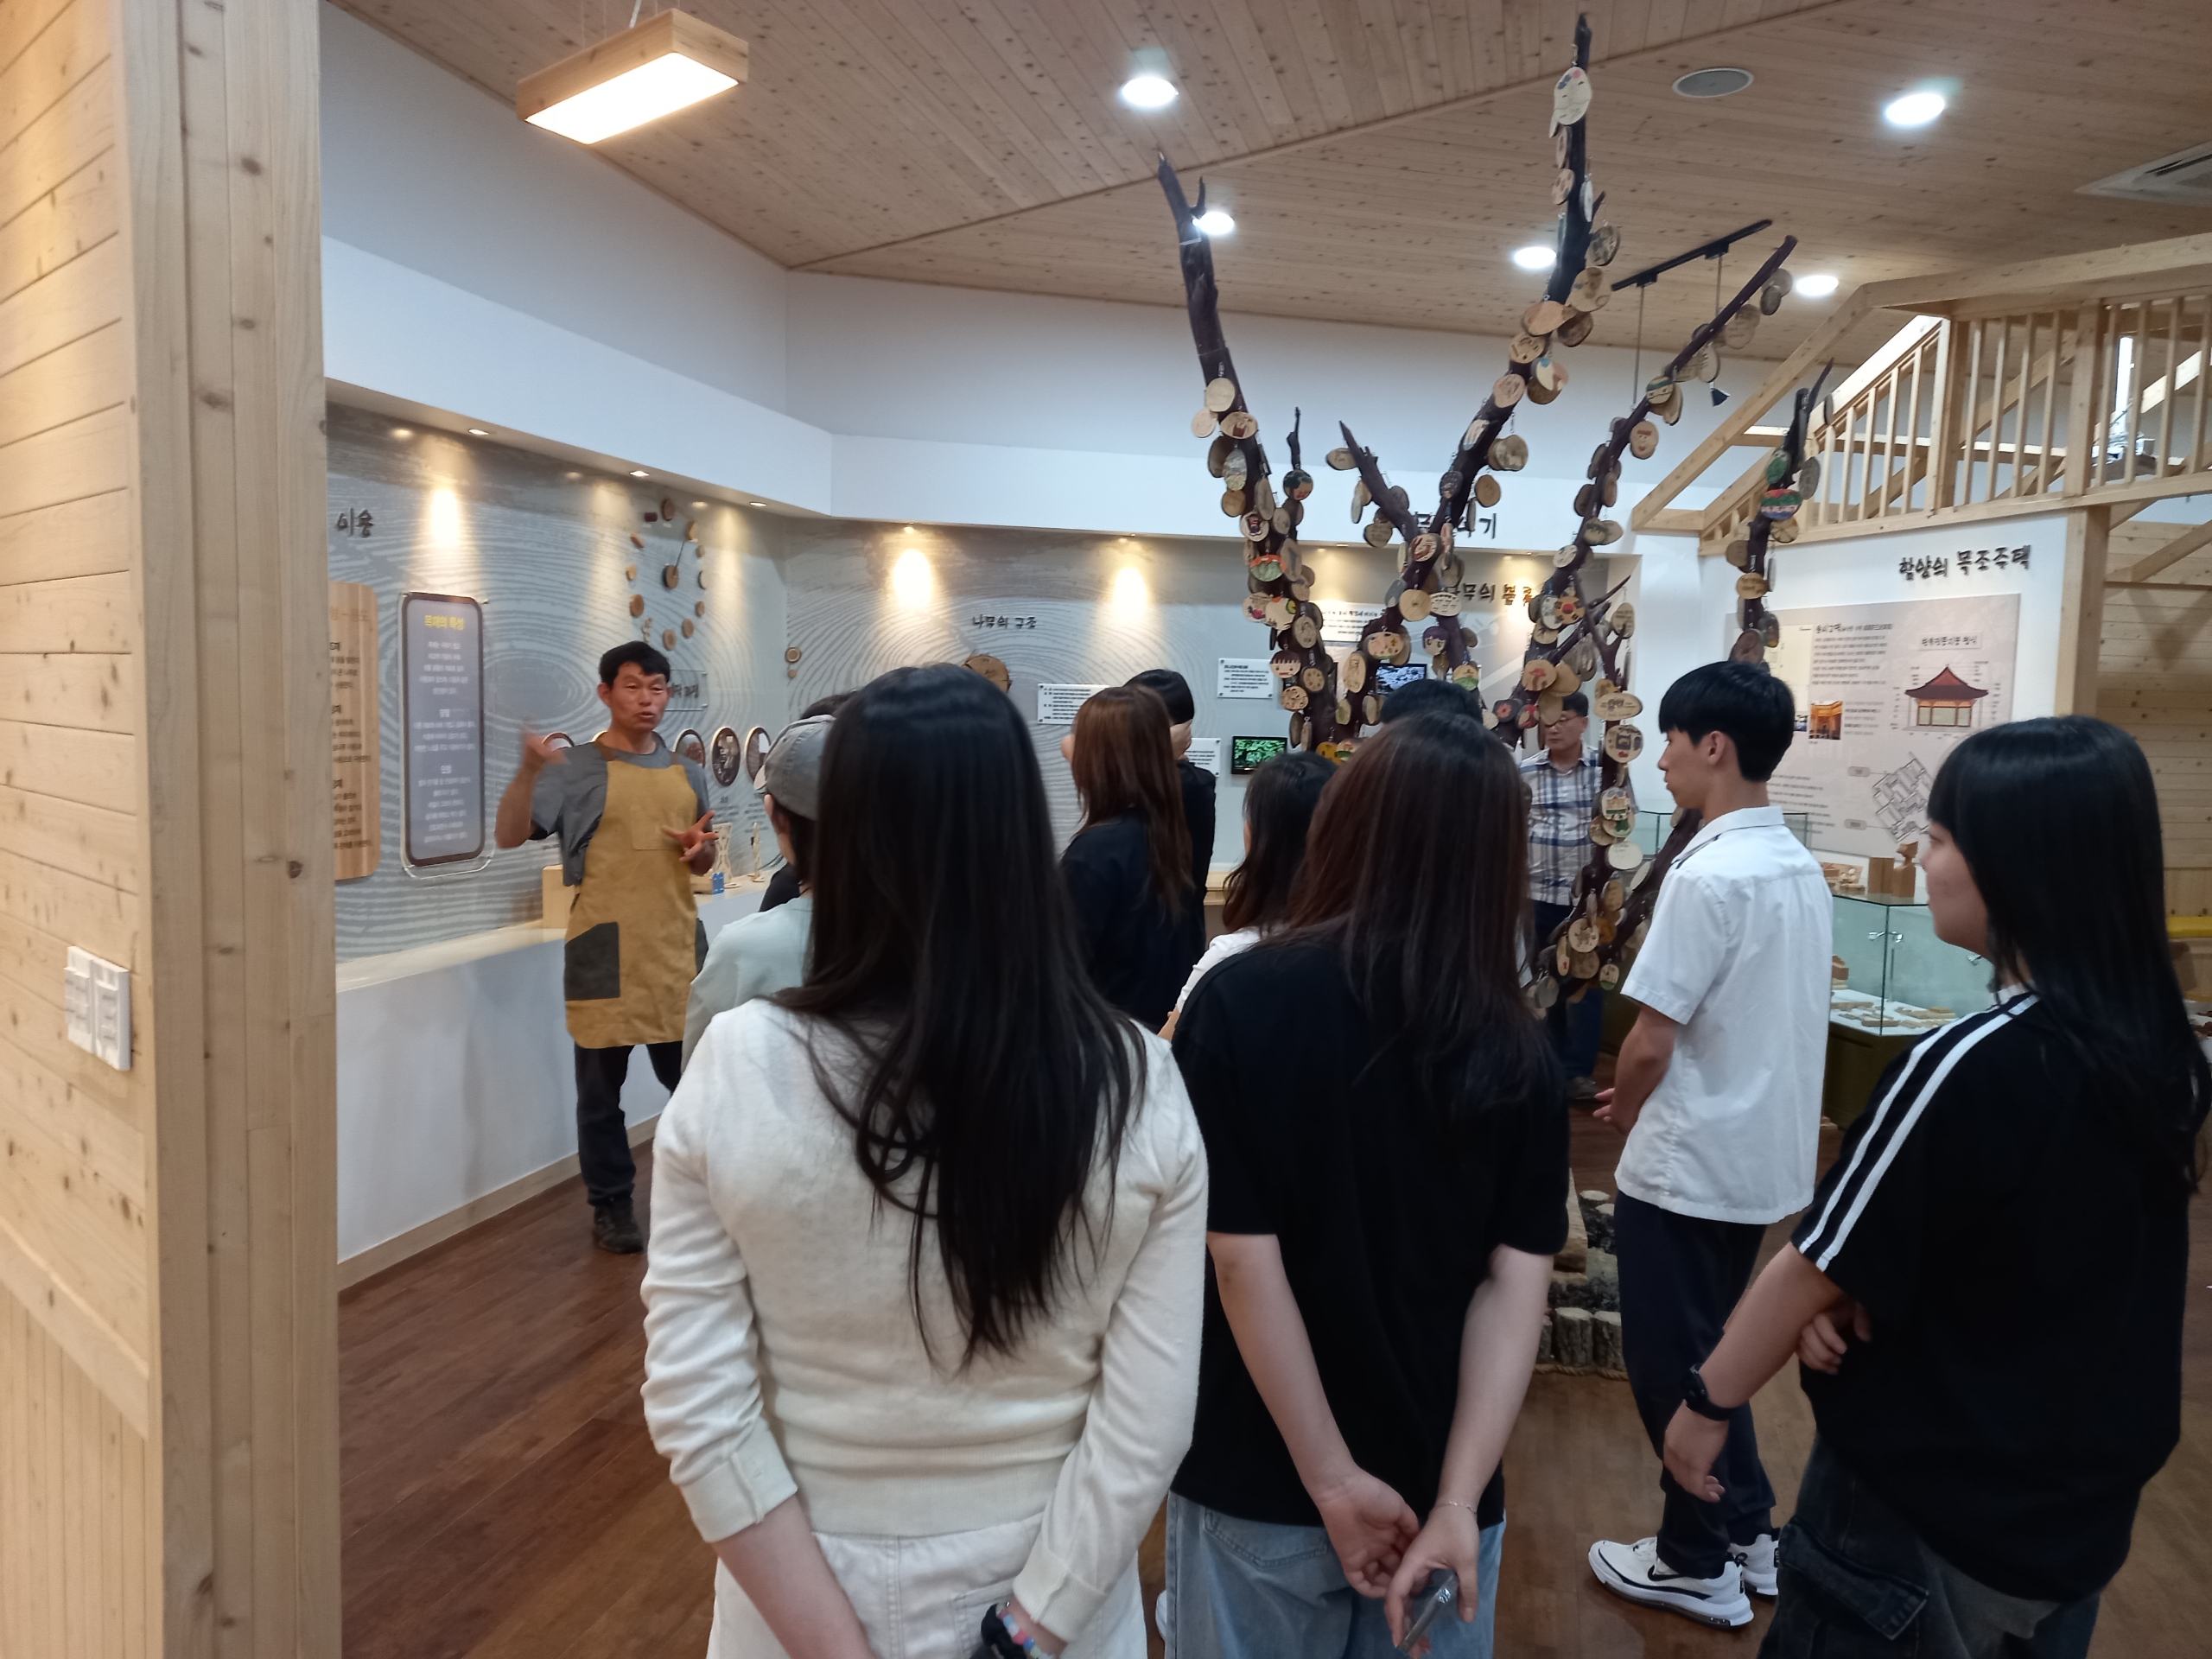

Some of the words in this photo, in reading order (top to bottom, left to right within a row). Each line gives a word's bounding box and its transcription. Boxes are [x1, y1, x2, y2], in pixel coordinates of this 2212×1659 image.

[335, 508, 374, 538] 이용
[1899, 555, 1948, 581] 함양의
[1957, 544, 2031, 575] 목조주택
[972, 613, 1008, 629] 나무의
[1015, 616, 1036, 629] 구조
